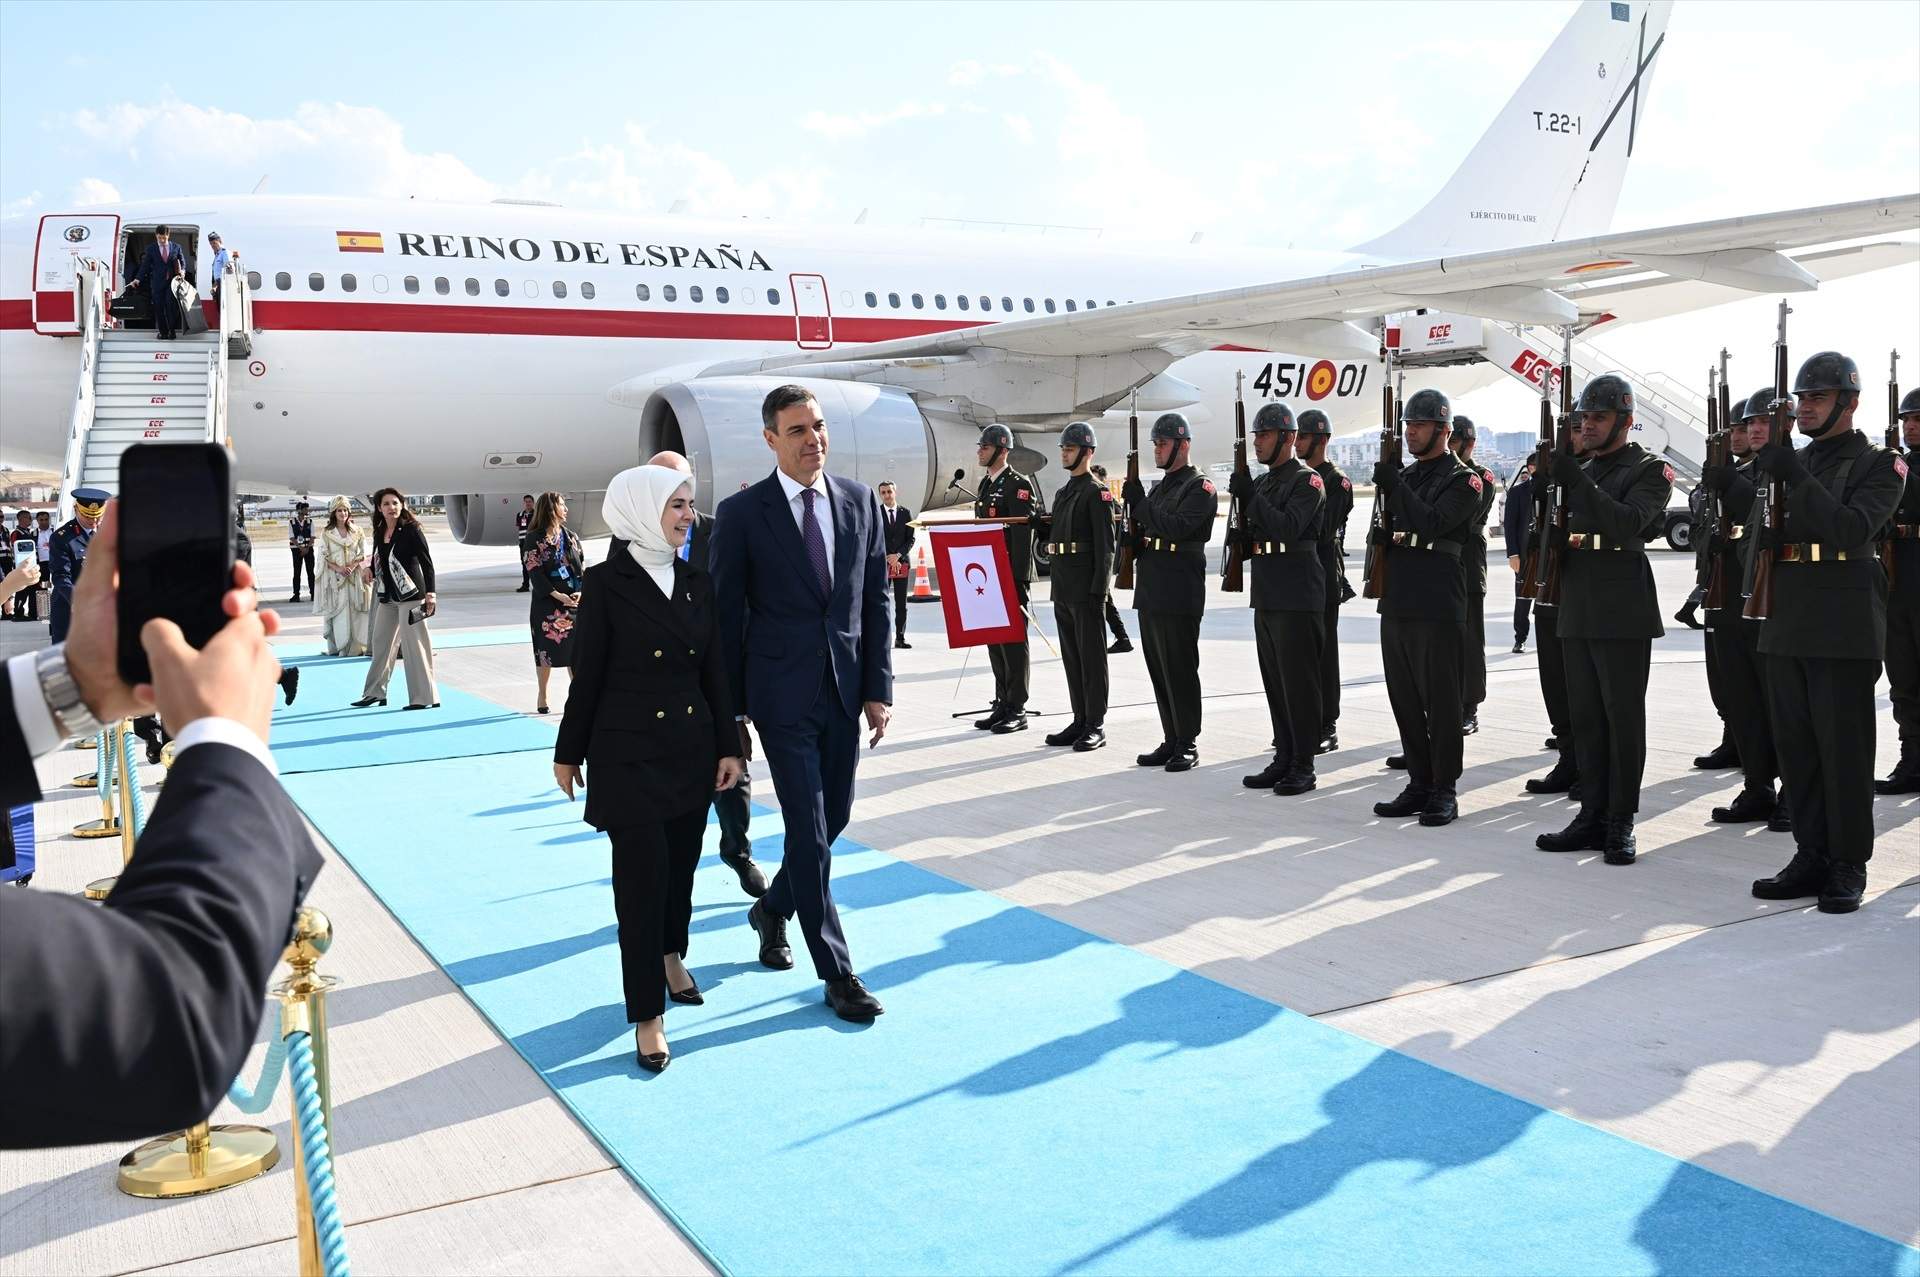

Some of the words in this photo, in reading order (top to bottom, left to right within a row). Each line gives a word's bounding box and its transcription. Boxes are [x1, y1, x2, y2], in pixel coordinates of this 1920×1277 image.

[1533, 111, 1580, 135] T.22-1
[1507, 213, 1520, 221] DEL
[397, 232, 541, 262] REINO
[551, 239, 609, 264] DE
[618, 243, 774, 271] ESPAÑA
[1253, 363, 1305, 397] 451
[1337, 364, 1367, 397] 01
